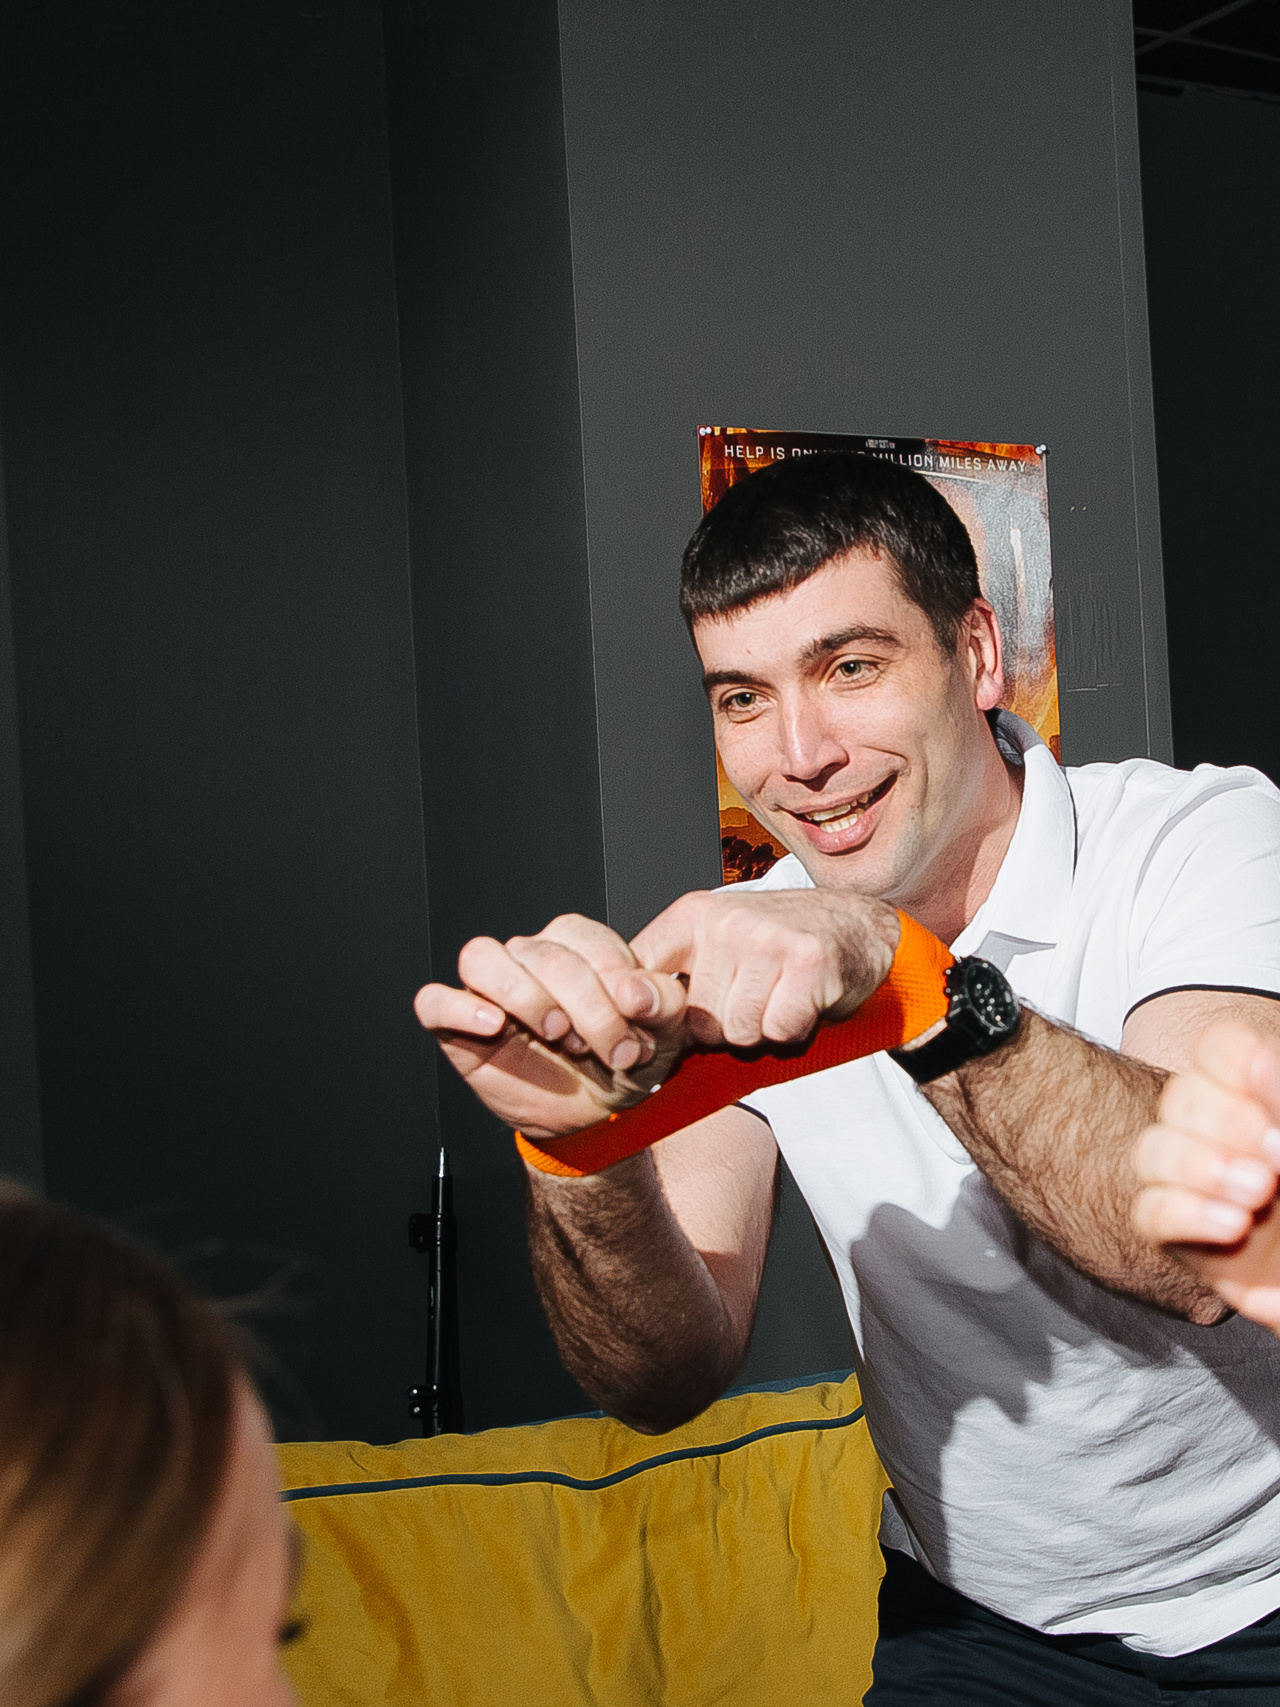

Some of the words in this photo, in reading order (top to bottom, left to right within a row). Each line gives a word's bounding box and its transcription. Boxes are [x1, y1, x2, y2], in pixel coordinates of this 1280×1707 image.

[724, 444, 764, 459] HELP
[770, 446, 785, 460] IS
[939, 455, 982, 471] MILES
[986, 458, 1026, 473] AWAY
